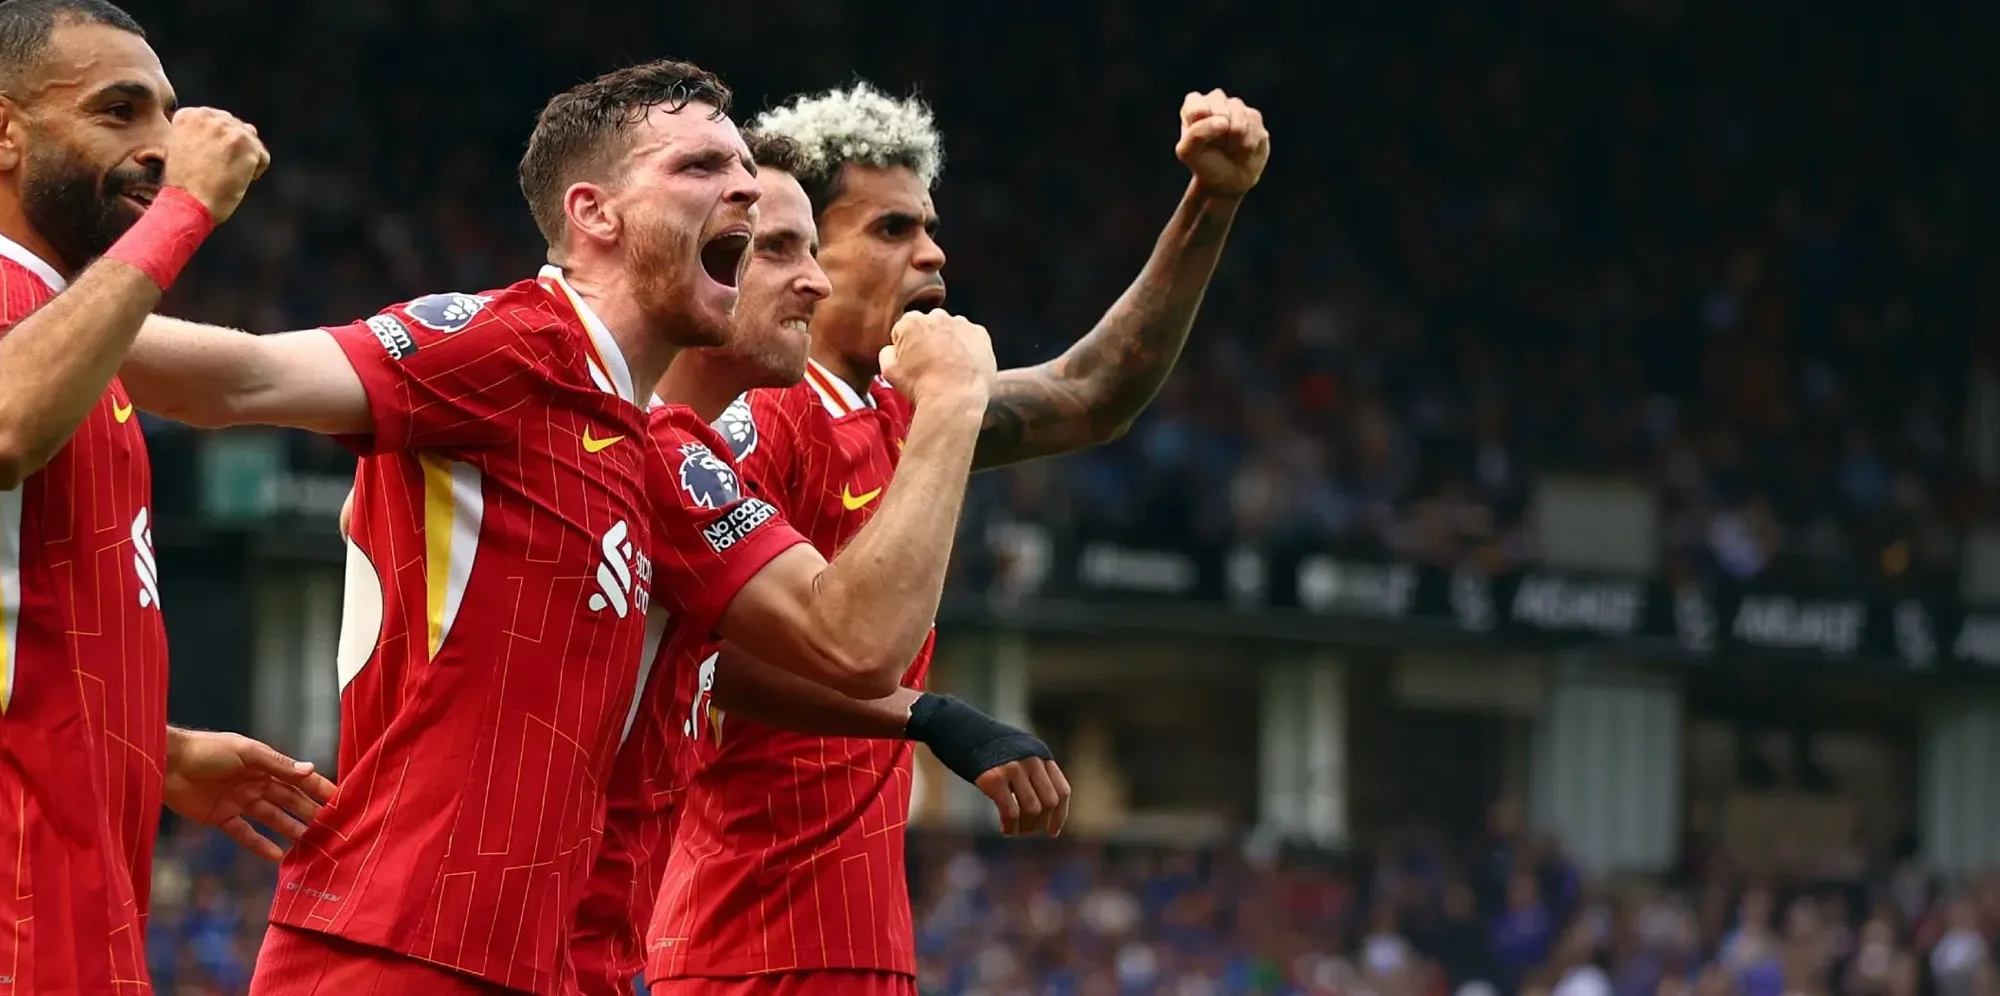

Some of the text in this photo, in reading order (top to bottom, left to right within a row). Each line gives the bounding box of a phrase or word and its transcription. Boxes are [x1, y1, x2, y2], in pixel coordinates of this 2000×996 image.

[703, 498, 764, 544] No room
[712, 531, 736, 553] for
